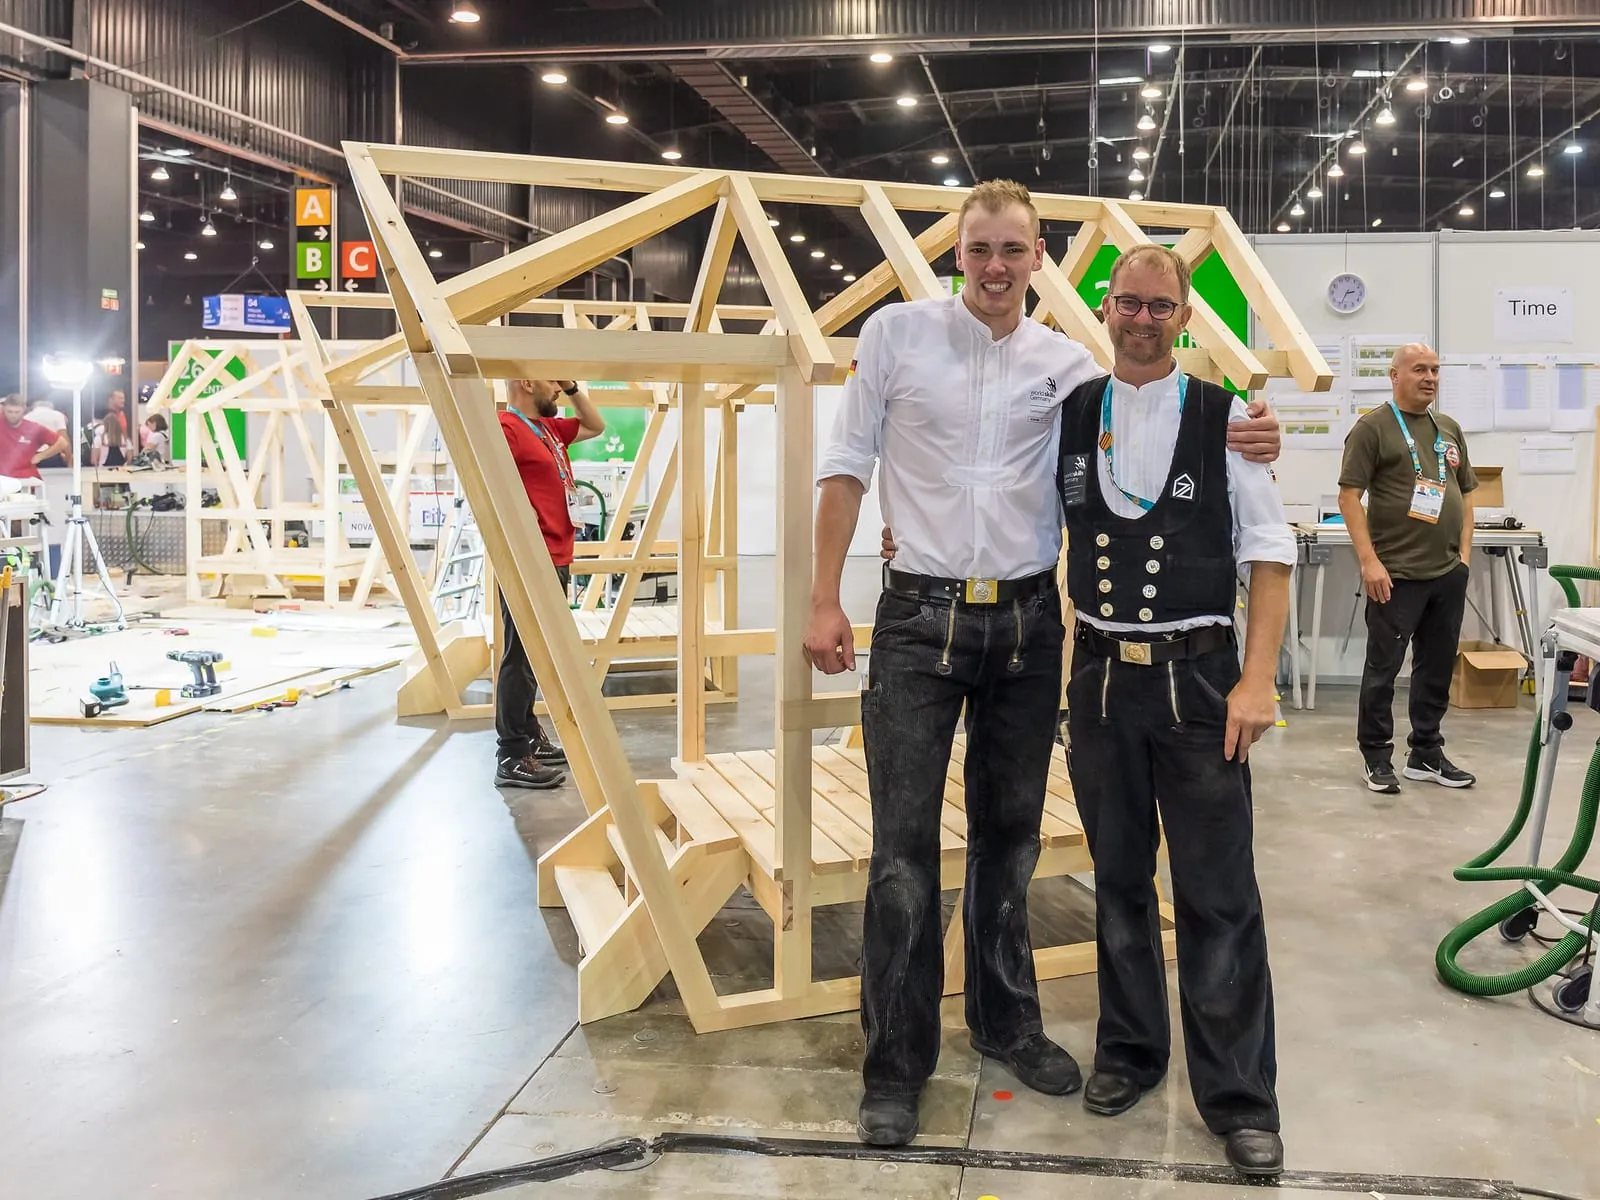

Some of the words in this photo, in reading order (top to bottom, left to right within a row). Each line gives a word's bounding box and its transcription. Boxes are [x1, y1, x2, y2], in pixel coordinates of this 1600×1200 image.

[302, 194, 325, 219] A
[305, 247, 322, 273] B
[349, 246, 369, 272] C
[1508, 299, 1557, 316] Time
